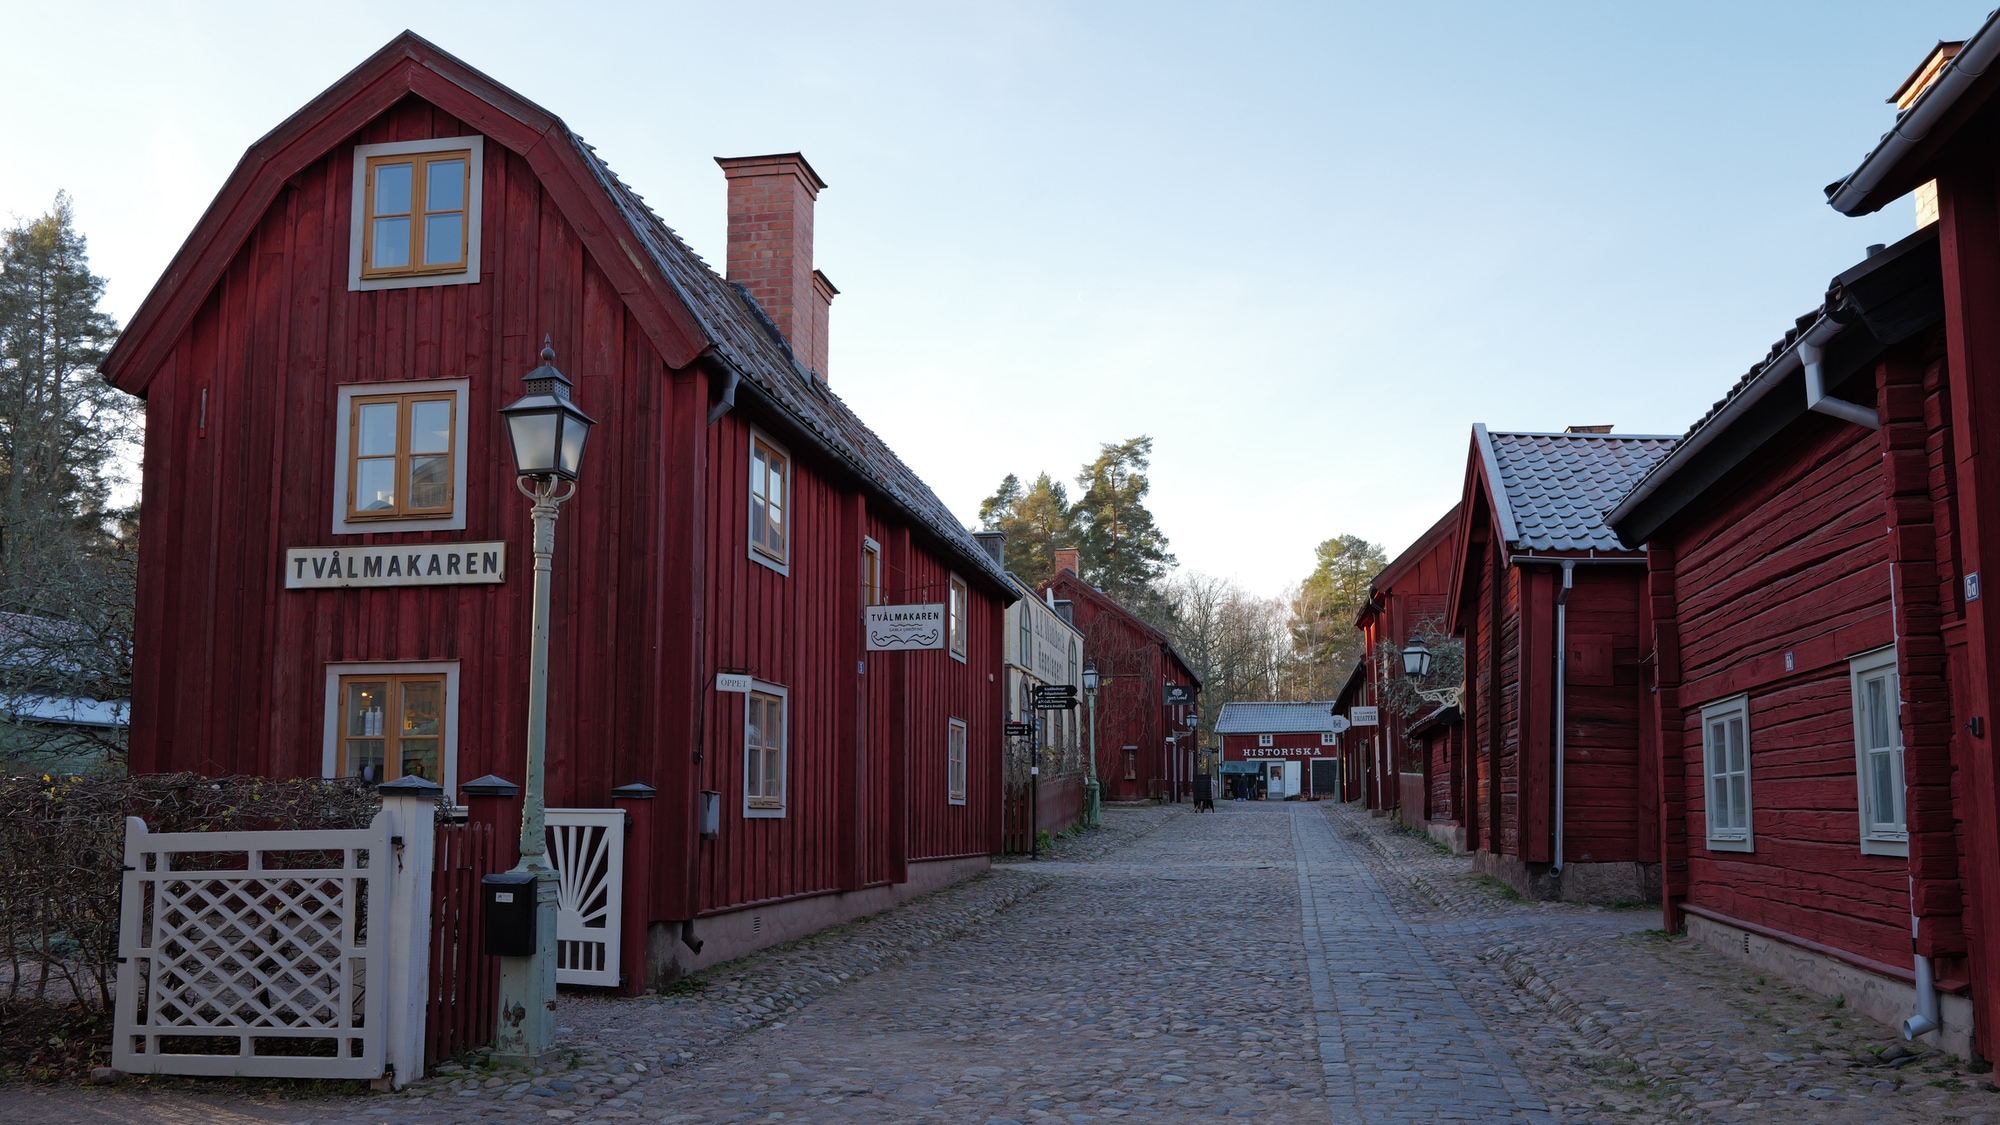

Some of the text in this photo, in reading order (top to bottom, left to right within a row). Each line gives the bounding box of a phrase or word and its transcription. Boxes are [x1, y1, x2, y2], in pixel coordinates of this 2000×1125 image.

[294, 551, 497, 579] TVÅLMAKAREN
[1966, 576, 1977, 598] 6a
[871, 612, 939, 621] TVÅLMAKAREN
[720, 678, 747, 688] ÖPPET
[1243, 747, 1322, 757] HISTORISKA
